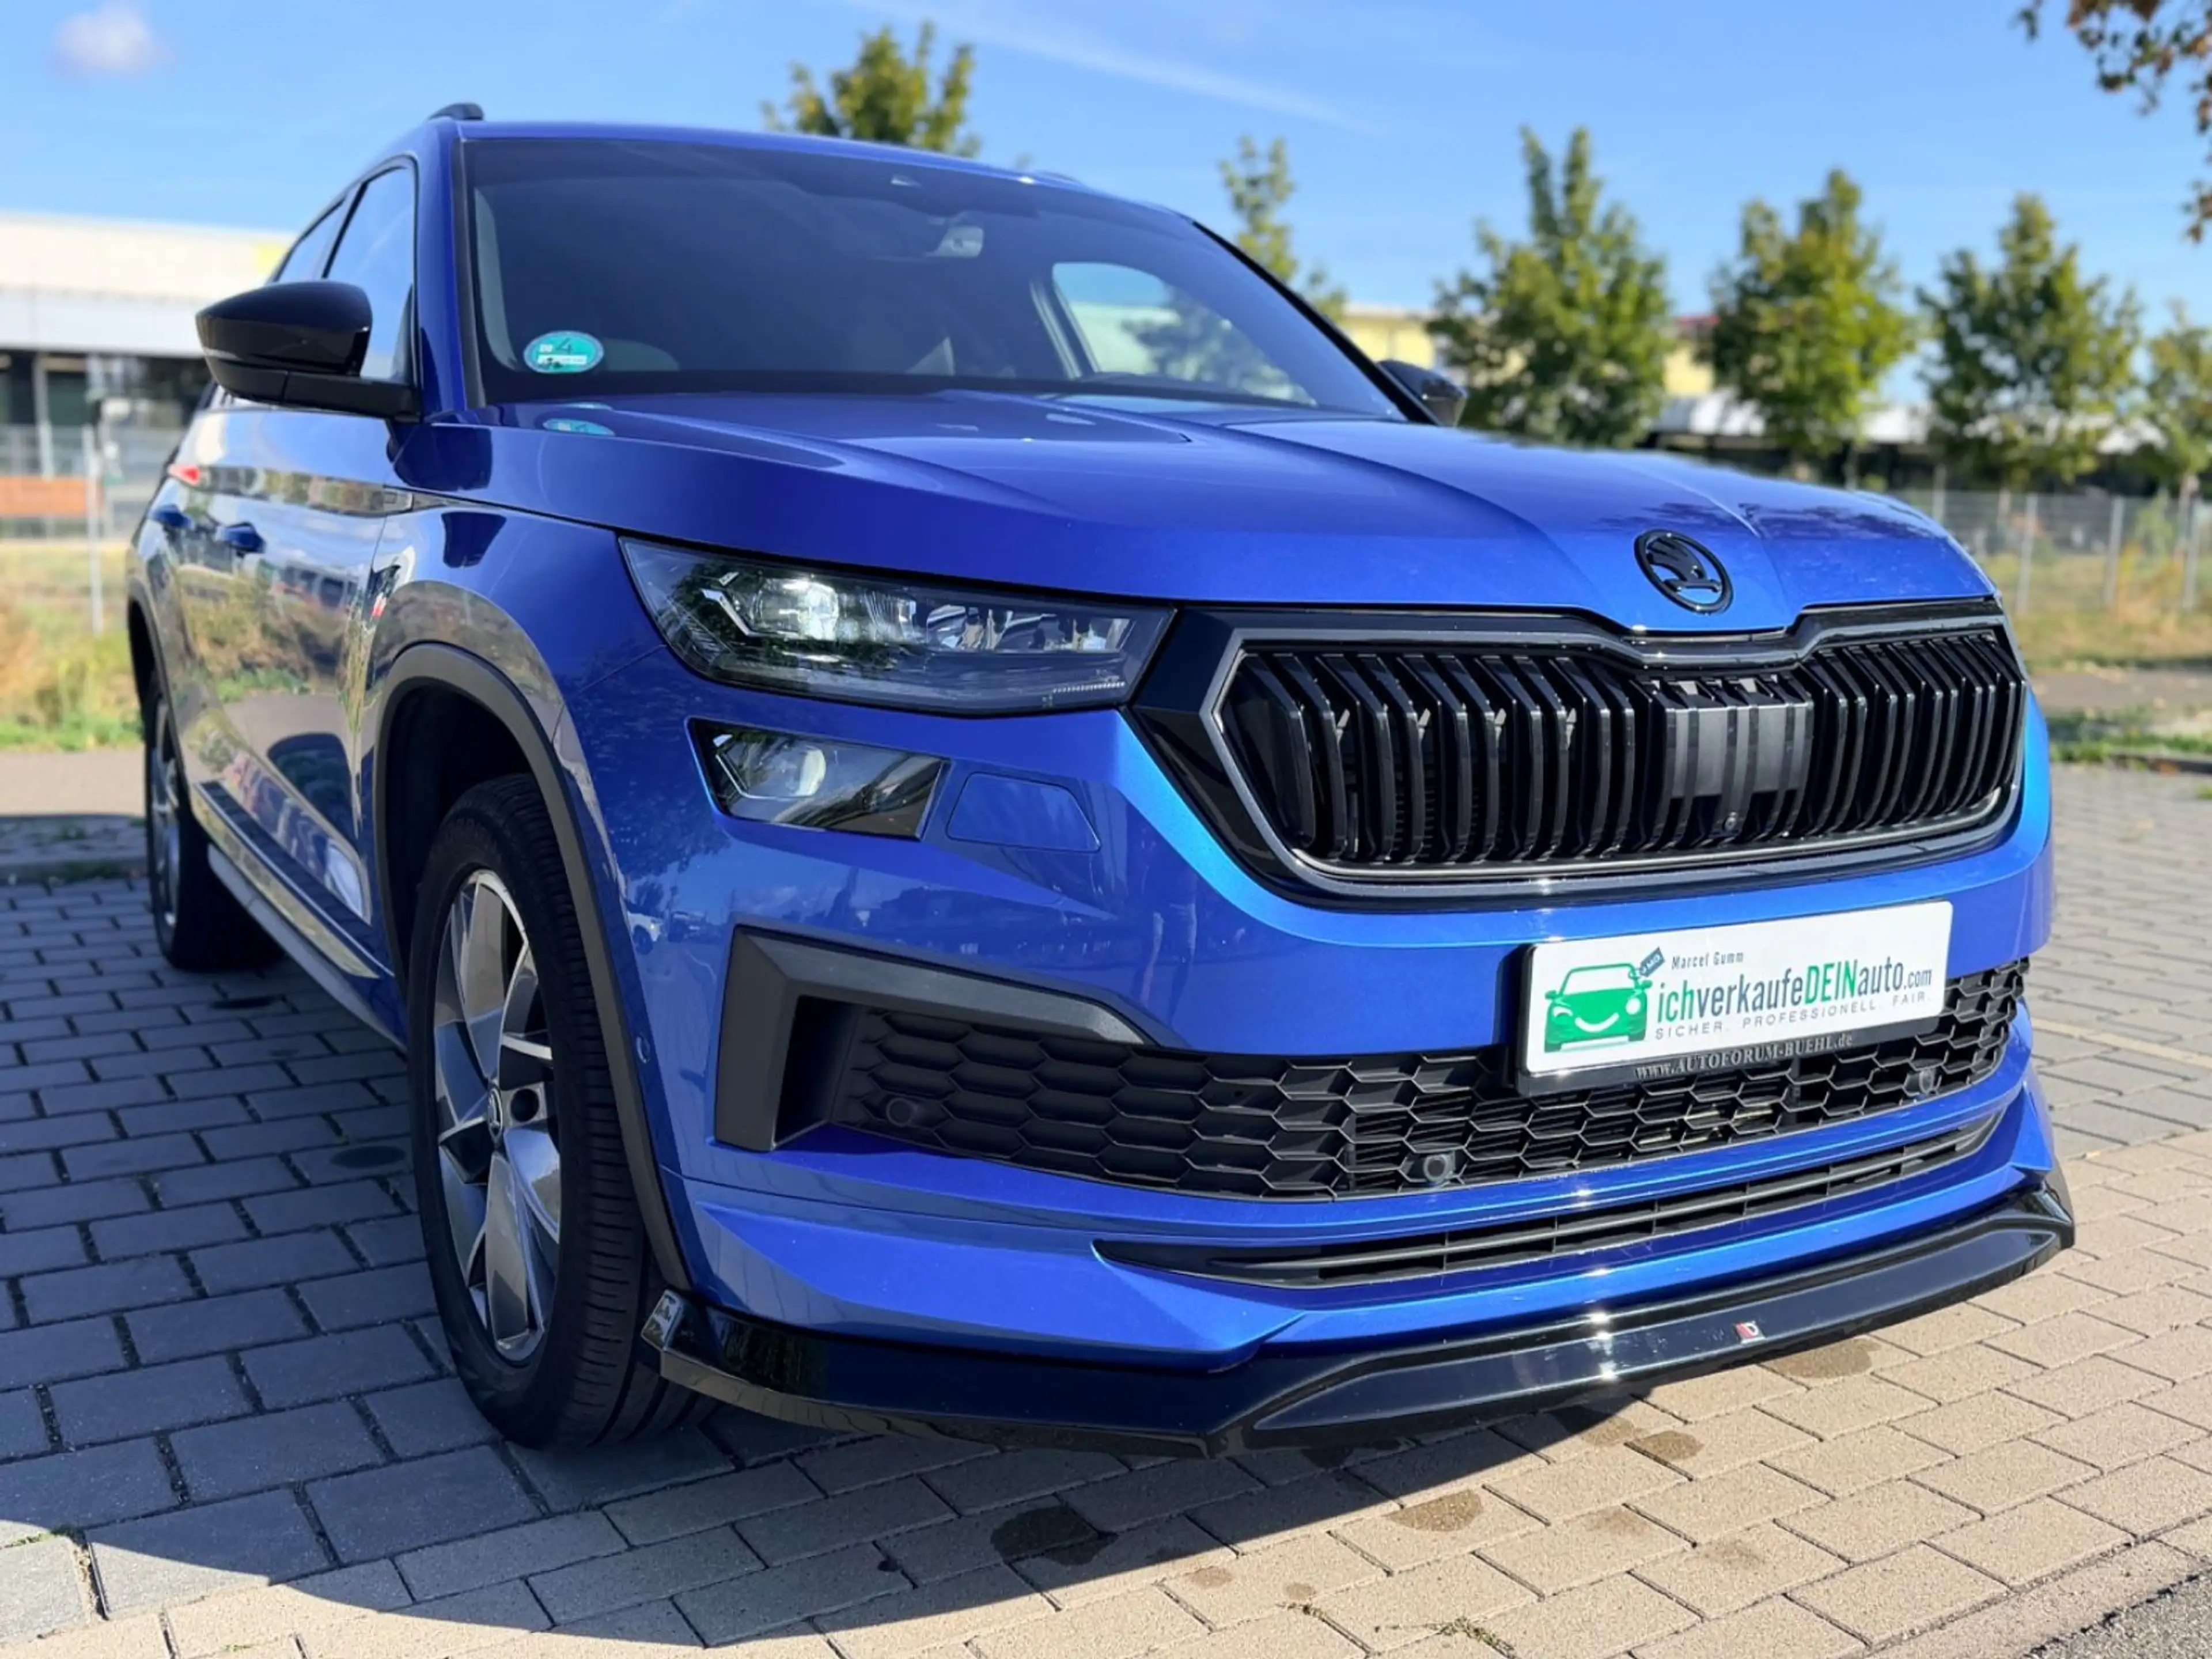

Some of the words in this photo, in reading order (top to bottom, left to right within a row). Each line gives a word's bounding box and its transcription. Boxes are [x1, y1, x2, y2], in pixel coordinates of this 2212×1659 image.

[1672, 952, 1709, 970] Marcel
[1713, 951, 1744, 966] Gumm
[1657, 956, 1933, 1023] ichverkaufeDEINauto.com
